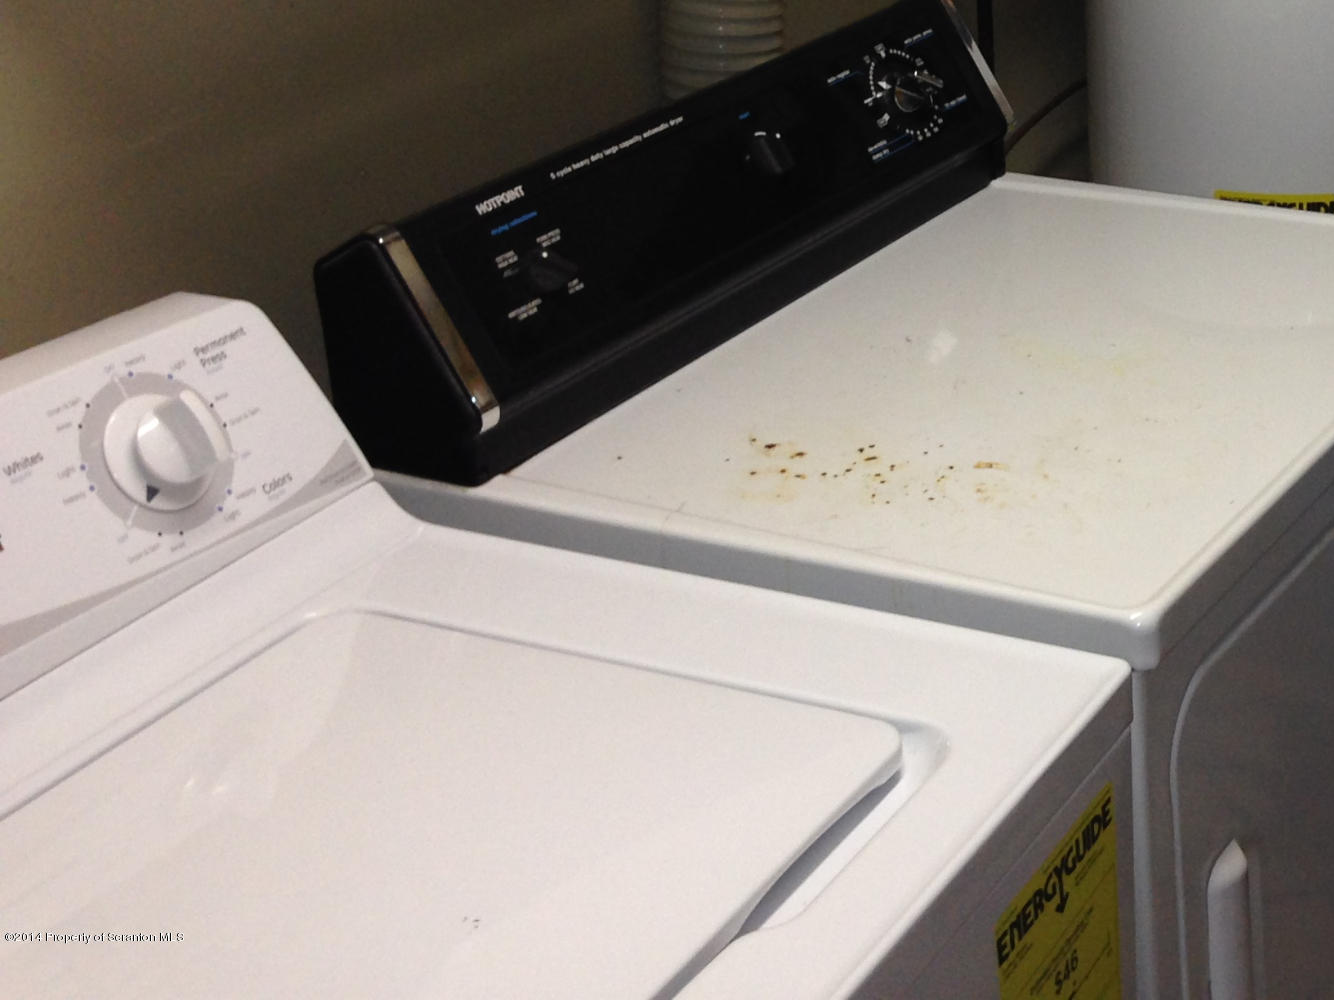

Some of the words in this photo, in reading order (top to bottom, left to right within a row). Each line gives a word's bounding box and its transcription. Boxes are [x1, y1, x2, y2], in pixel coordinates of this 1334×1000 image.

[475, 185, 525, 216] HOTPOINT
[193, 327, 247, 356] Permanent
[200, 351, 228, 368] Press
[3, 452, 44, 476] Whites
[262, 472, 293, 495] Colors
[996, 797, 1114, 969] ENERGYGUIDE
